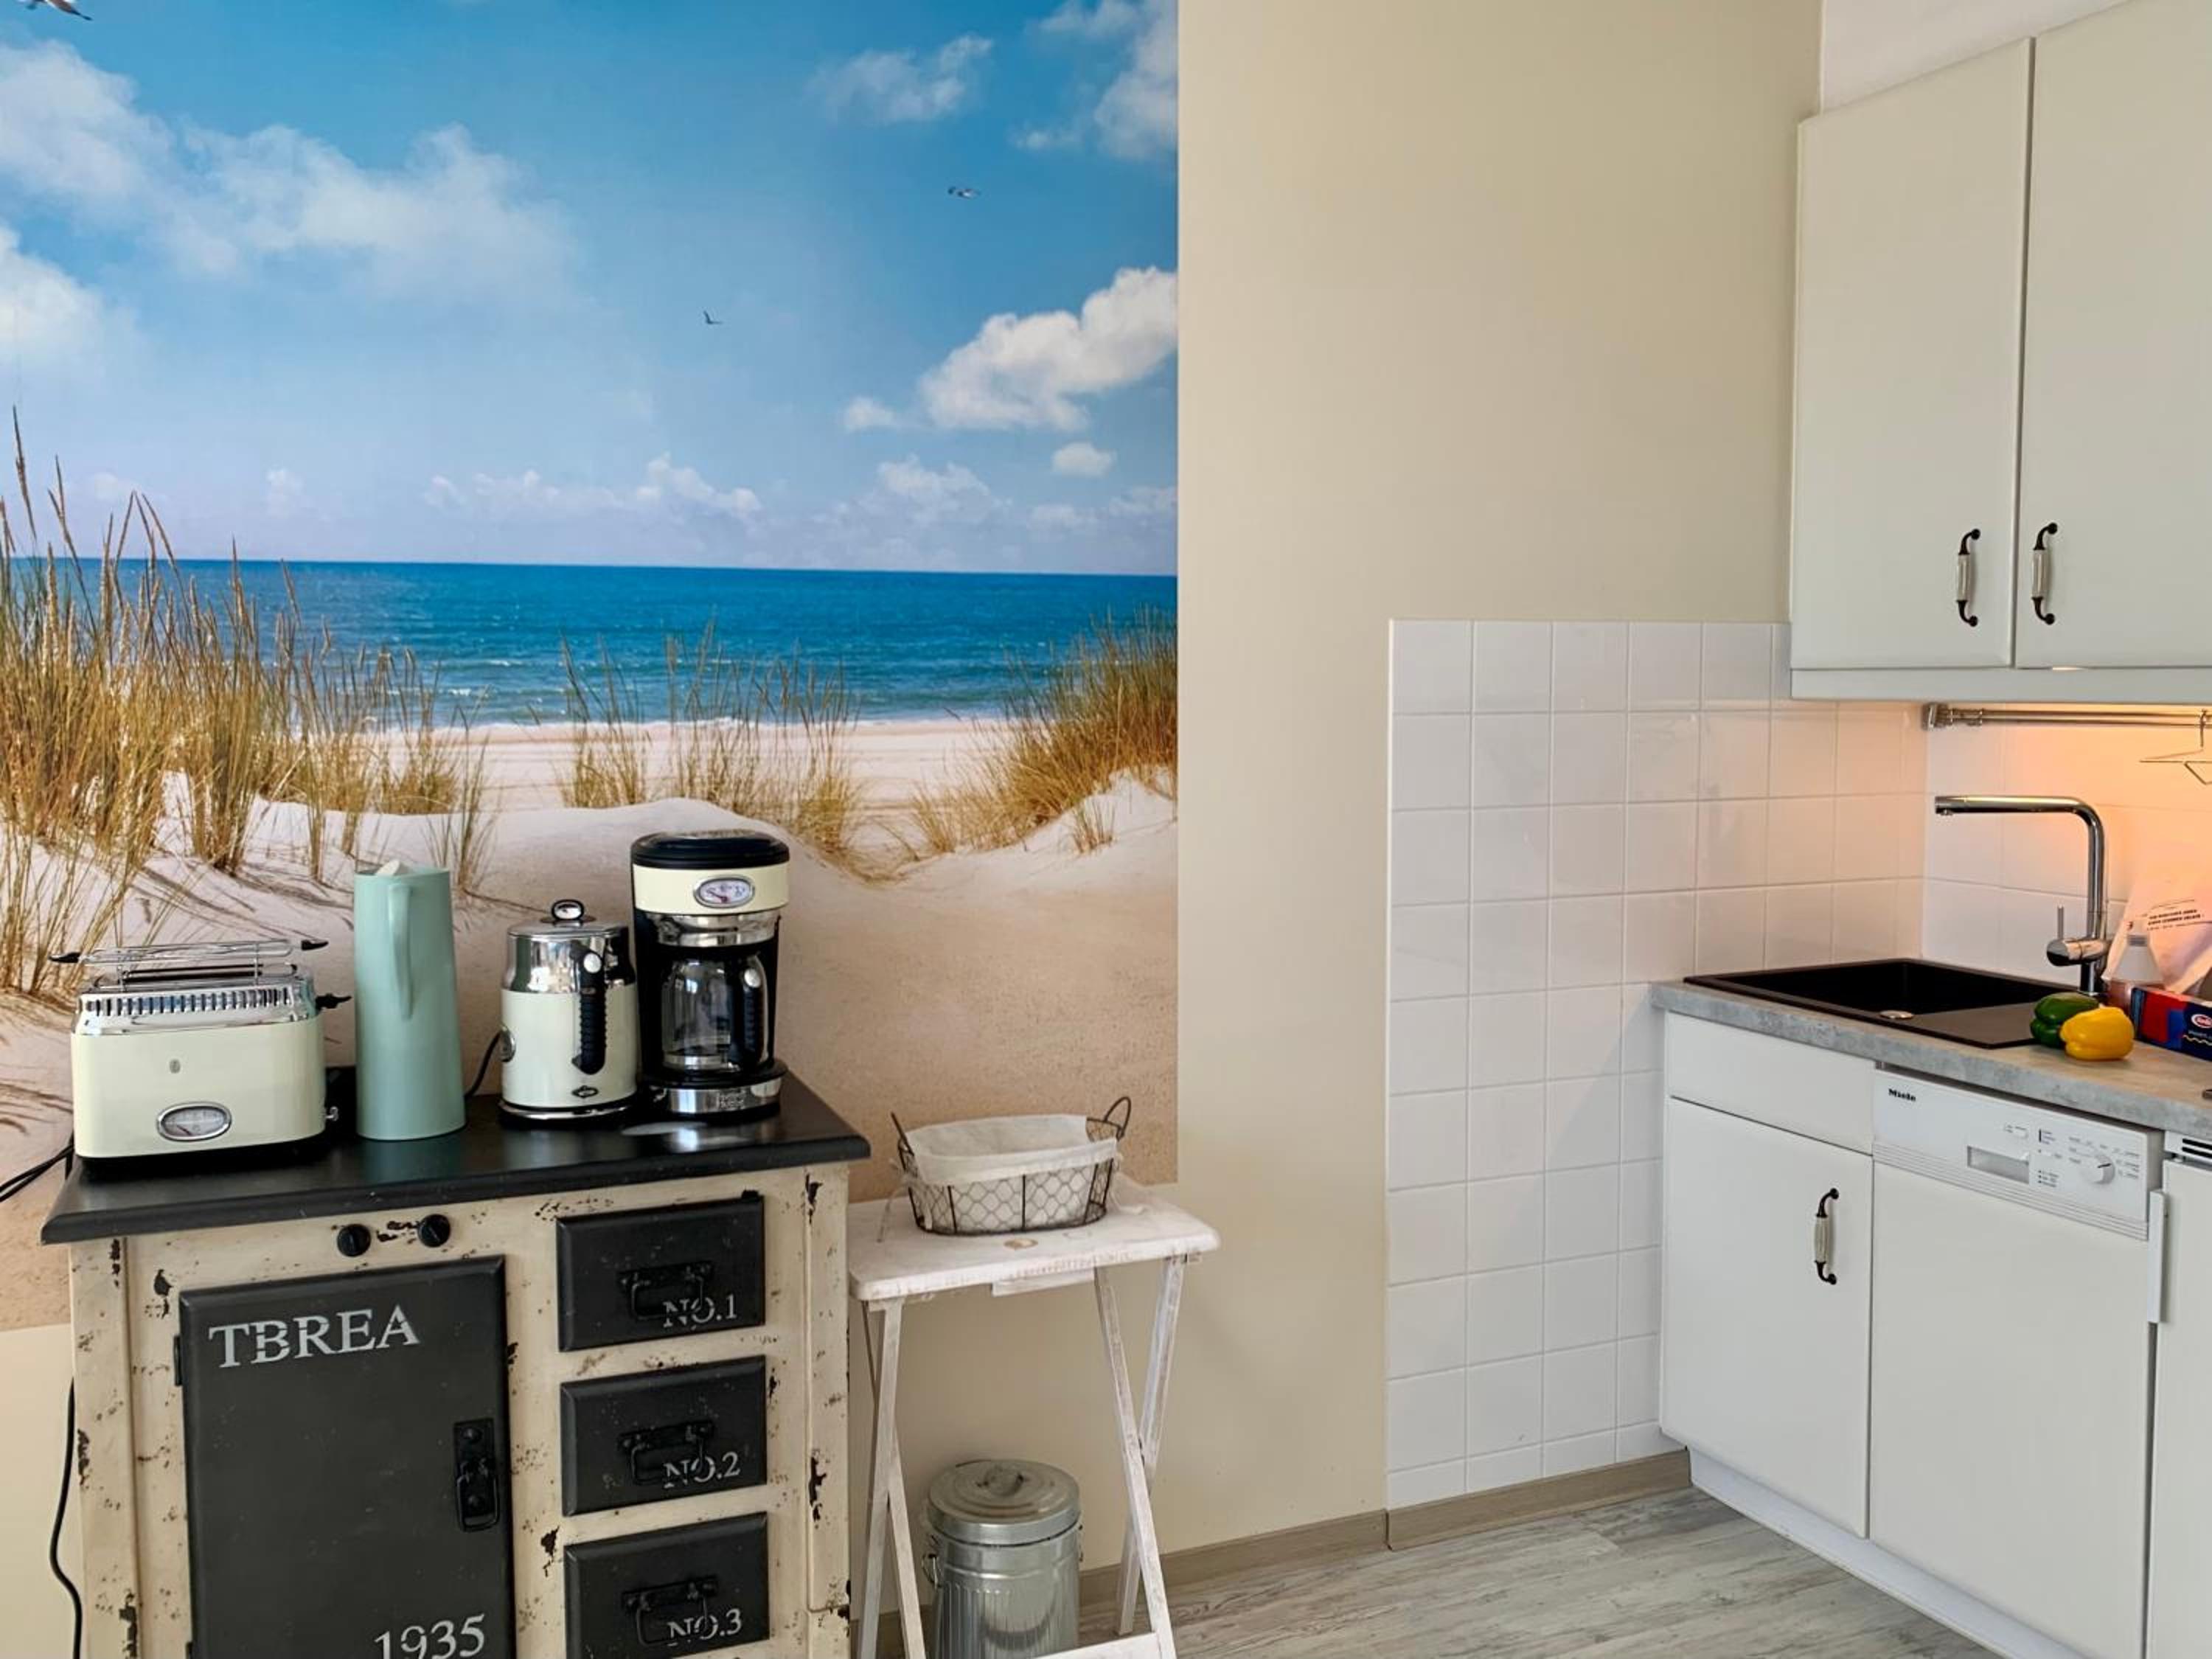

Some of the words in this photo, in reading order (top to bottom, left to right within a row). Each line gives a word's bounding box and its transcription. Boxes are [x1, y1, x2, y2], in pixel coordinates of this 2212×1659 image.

[663, 1293, 737, 1328] NO.1
[209, 1304, 420, 1368] TBREA
[664, 1451, 741, 1489] NO.2
[374, 1613, 485, 1659] 1935
[667, 1608, 742, 1646] NO.3
